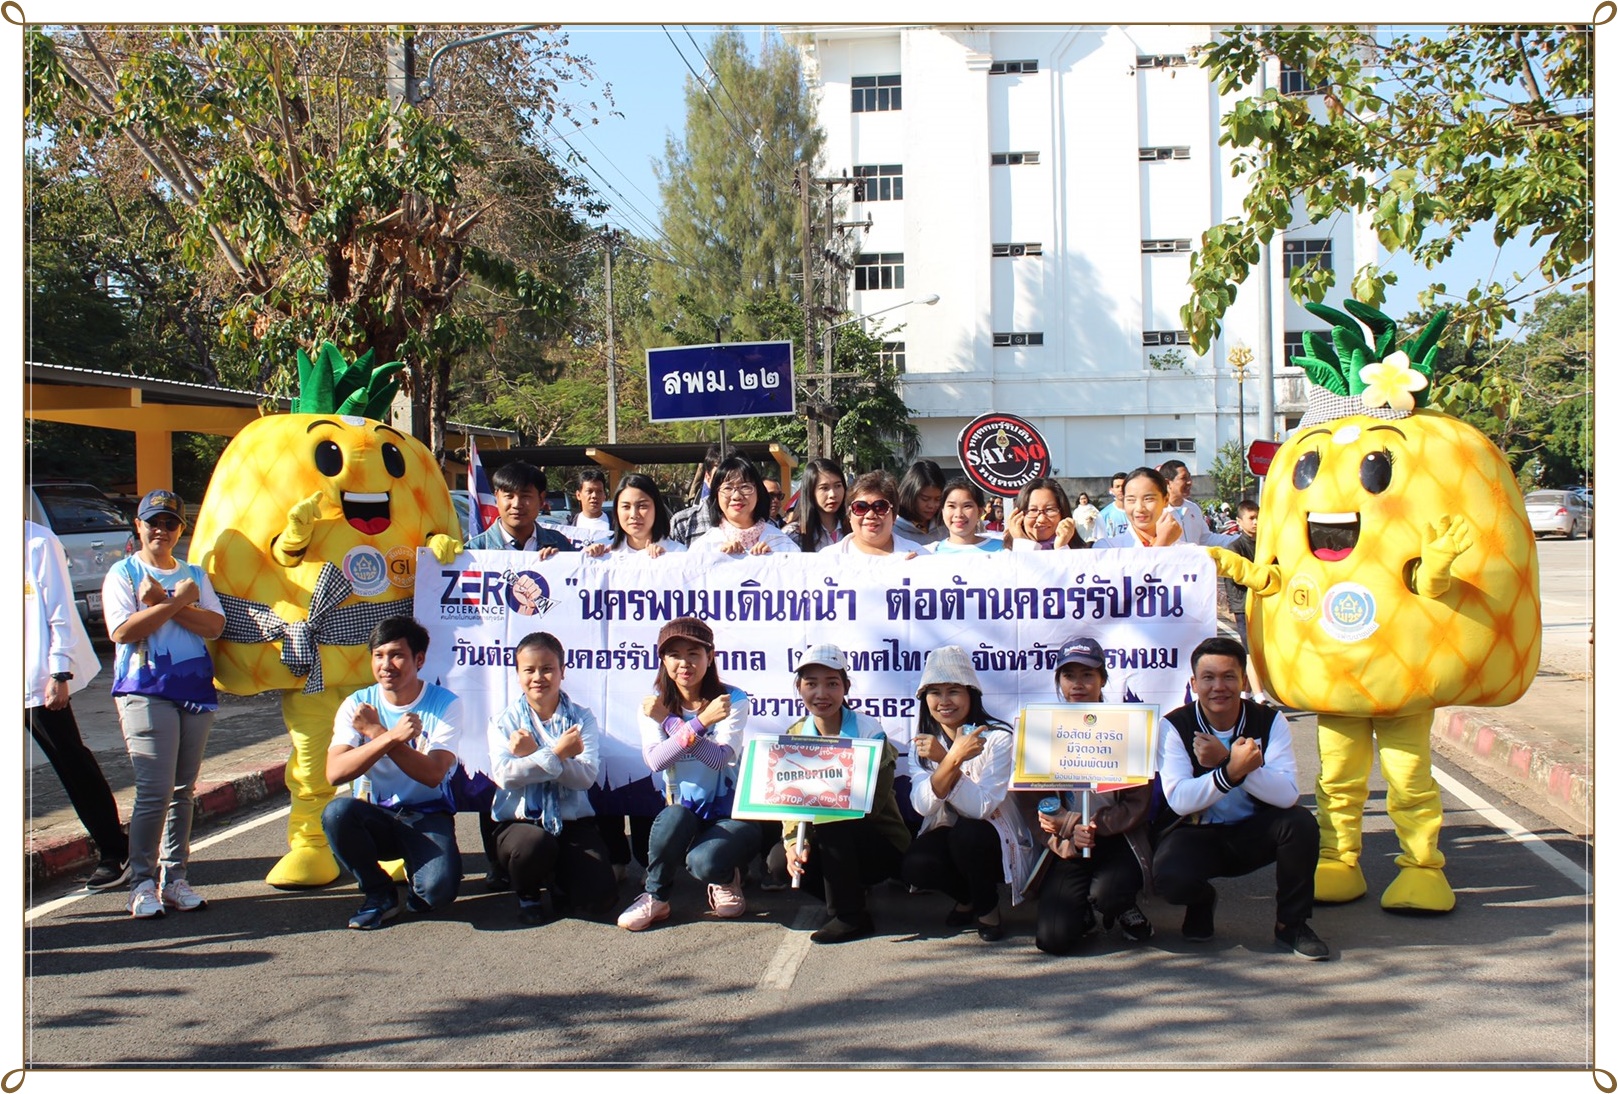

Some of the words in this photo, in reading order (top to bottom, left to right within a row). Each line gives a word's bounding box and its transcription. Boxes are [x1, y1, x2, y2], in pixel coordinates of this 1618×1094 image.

[966, 447, 1007, 466] SAY
[1012, 443, 1046, 462] NO
[565, 576, 857, 621] "นครพนมเดินหน้า
[886, 573, 1197, 620] ต่อต้านคอร์รัปชัน"
[440, 605, 505, 615] TOLERANCE
[850, 698, 915, 718] 2562
[776, 768, 843, 782] CORRUPTION
[781, 794, 803, 804] STOP
[819, 795, 837, 804] STOP
